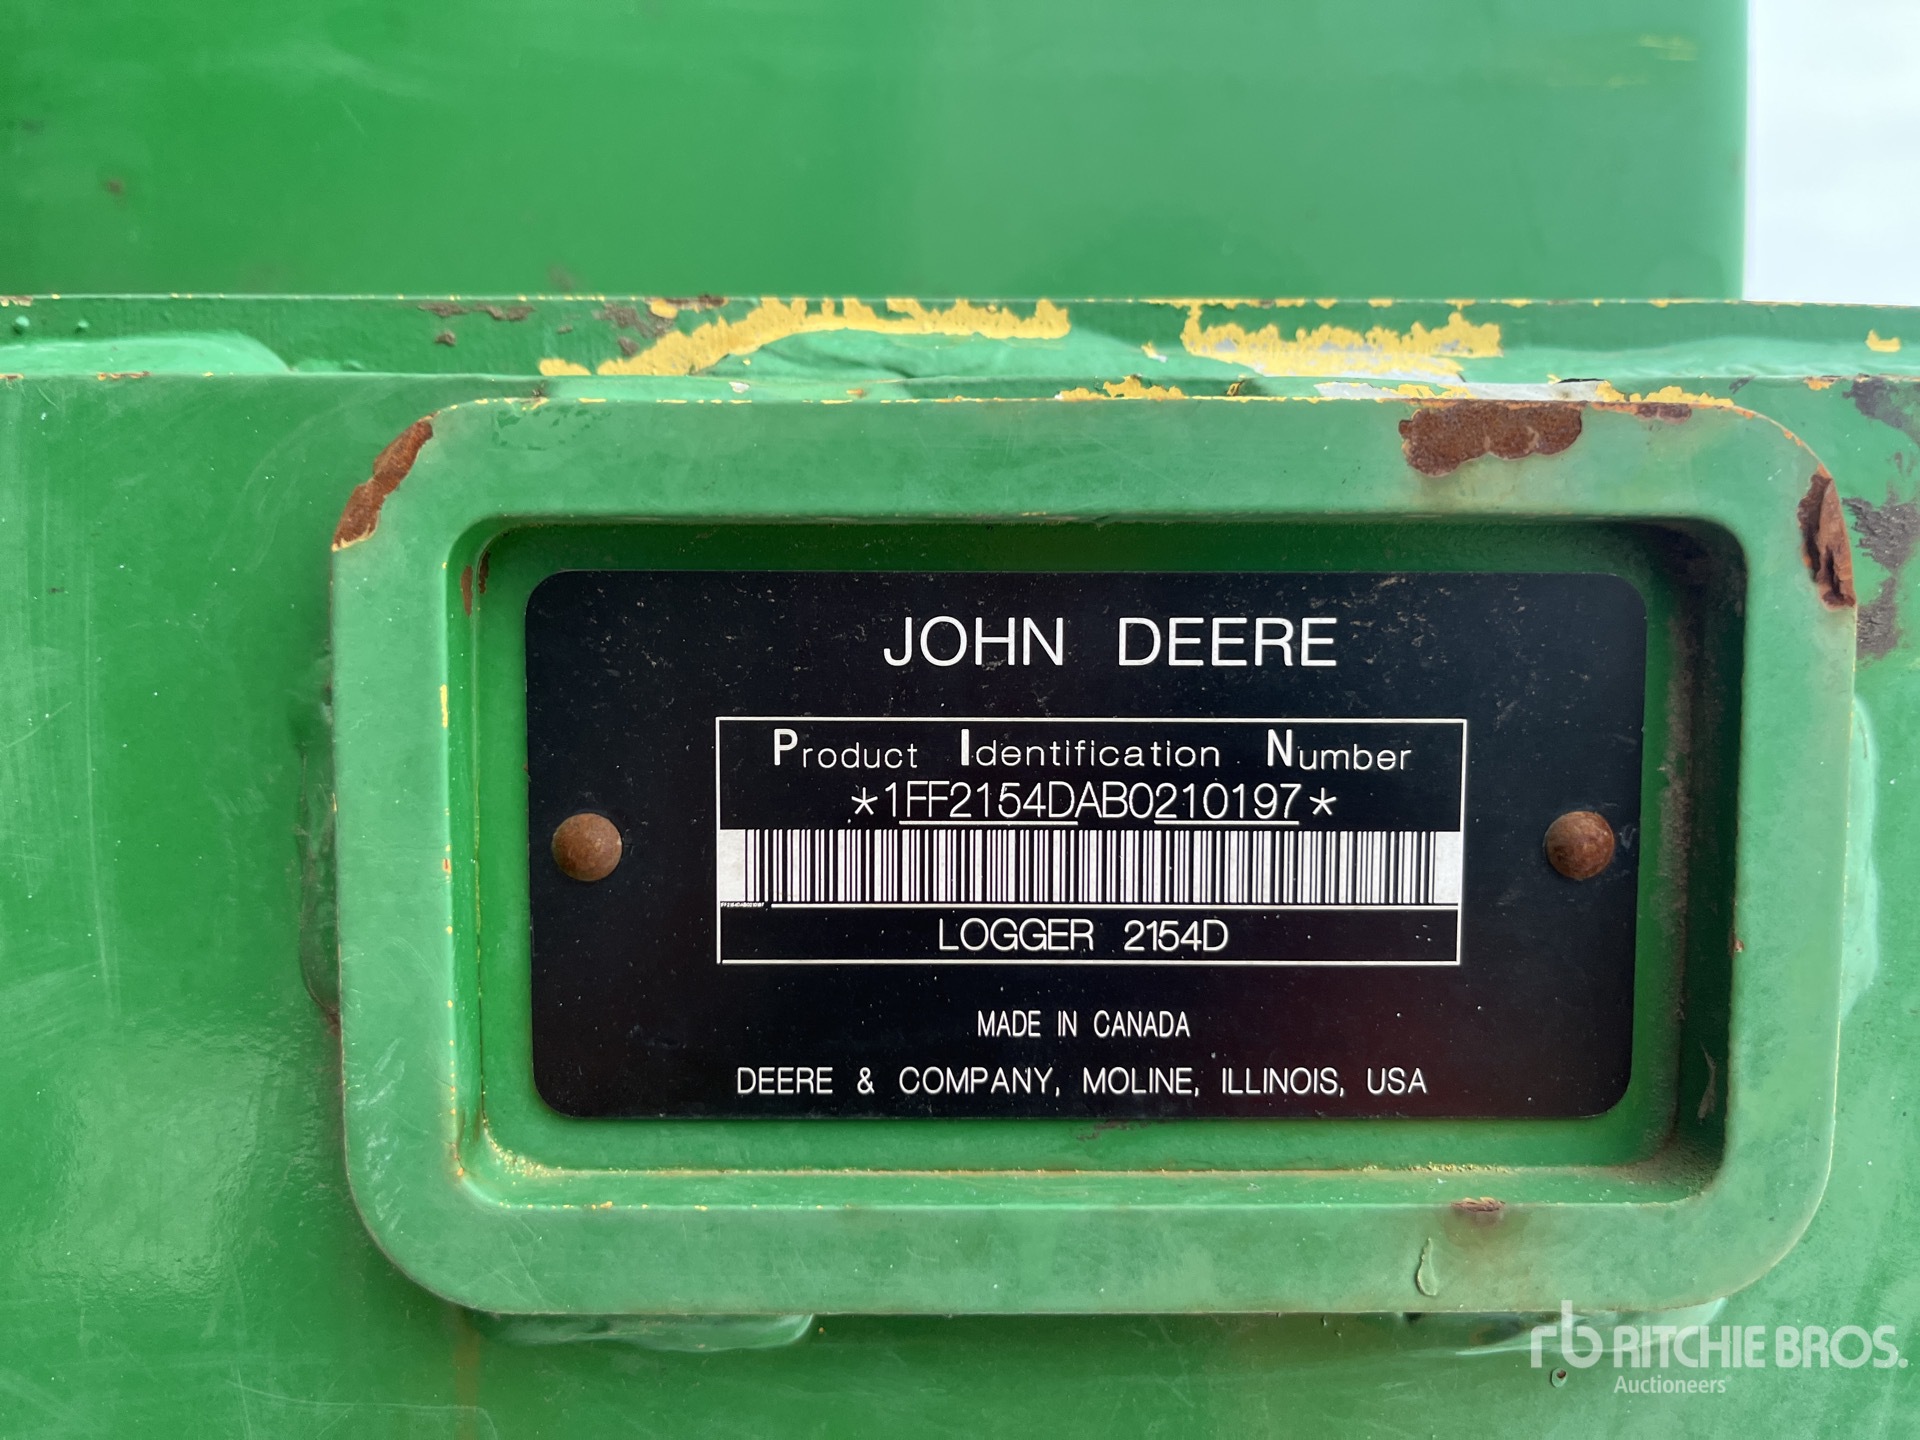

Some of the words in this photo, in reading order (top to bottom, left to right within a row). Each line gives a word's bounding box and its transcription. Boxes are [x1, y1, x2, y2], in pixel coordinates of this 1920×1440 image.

[884, 616, 1063, 666] JOHN
[1118, 617, 1337, 666] DEERE
[773, 728, 917, 768] Product
[961, 728, 1219, 768] Identification
[1267, 729, 1411, 770] Number
[938, 917, 1093, 951] LOGGER
[1124, 919, 1228, 951] 2154D
[977, 1010, 1041, 1037] MADE
[1057, 1010, 1077, 1037] IN
[1093, 1010, 1191, 1037] CANADA
[737, 1066, 833, 1094] DEERE
[857, 1067, 875, 1094] &
[899, 1066, 1060, 1097] COMPANY,
[1083, 1066, 1199, 1097] MOLINE,
[1222, 1067, 1344, 1097] ILLINOIS,
[1367, 1067, 1427, 1095] USA
